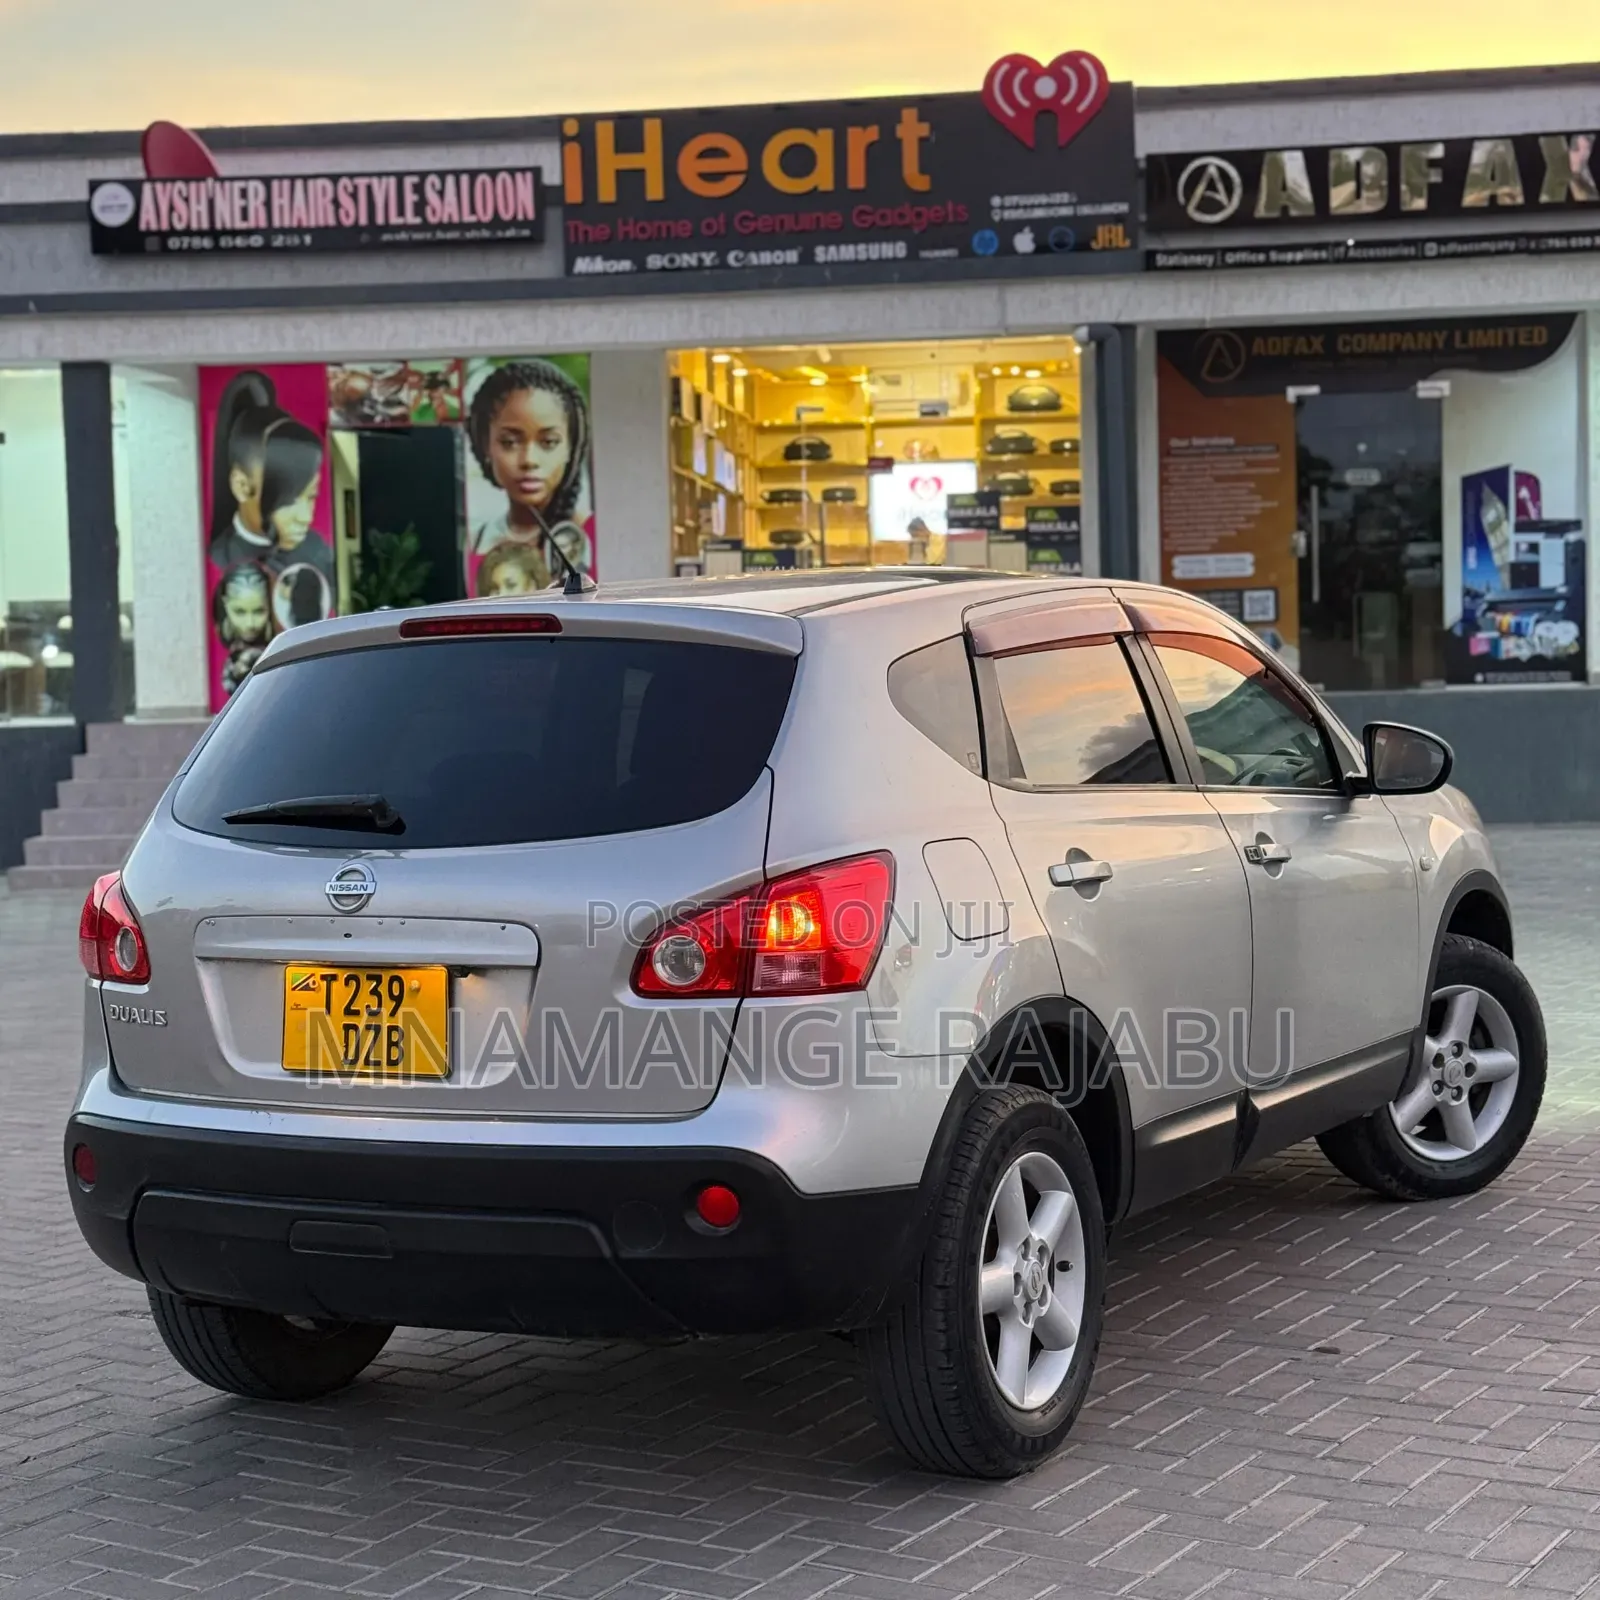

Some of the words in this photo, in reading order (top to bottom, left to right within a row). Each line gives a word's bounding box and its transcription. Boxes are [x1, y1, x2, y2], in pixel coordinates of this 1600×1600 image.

[562, 107, 932, 204] iHeart
[1253, 133, 1600, 219] ADFAX
[138, 178, 268, 231] AYSH'NER
[424, 170, 536, 224] SALOON
[566, 220, 611, 243] The
[617, 215, 693, 240] Home
[701, 213, 726, 236] of
[734, 207, 843, 235] Genuine
[852, 201, 969, 231] Gadgets
[645, 251, 717, 271] SONY
[726, 248, 800, 268] Canon
[813, 241, 908, 264] SAMSUNG
[1154, 251, 1216, 269] Stationery
[1224, 250, 1267, 266] Office
[1268, 246, 1328, 263] Supplies
[572, 256, 634, 275] Nikon
[1251, 335, 1325, 356] ADFAX
[1336, 330, 1449, 352] COMPANY
[1453, 325, 1549, 349] LIMITED
[328, 883, 369, 892] NISSAN
[109, 1003, 168, 1027] DUALIS
[341, 1022, 406, 1067] DZB
